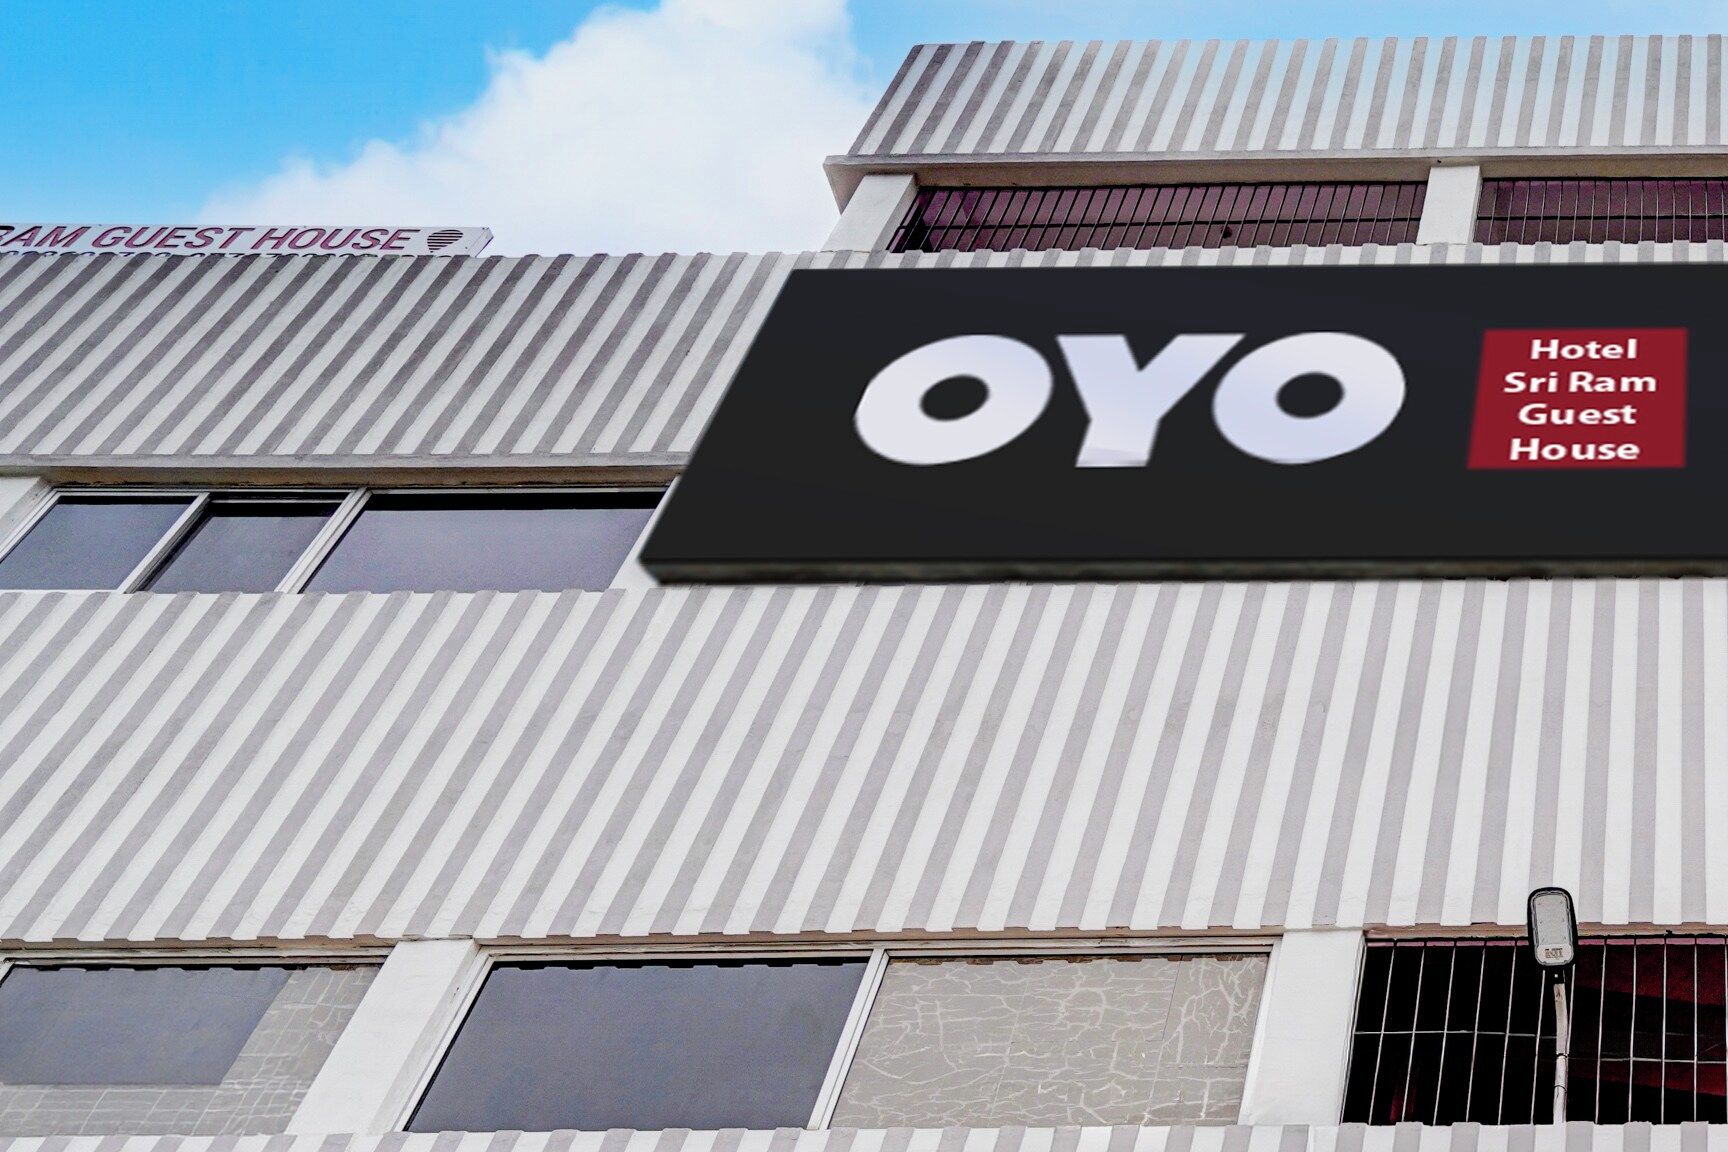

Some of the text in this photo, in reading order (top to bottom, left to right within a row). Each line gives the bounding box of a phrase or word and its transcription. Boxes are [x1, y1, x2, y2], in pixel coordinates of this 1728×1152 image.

[91, 226, 256, 249] GUEST
[250, 227, 421, 250] HOUSE
[1530, 338, 1637, 360] Hotel
[1503, 371, 1657, 393] Sri Ram
[854, 331, 1406, 467] OYO
[1518, 403, 1637, 425] Guest
[1509, 438, 1640, 461] House
